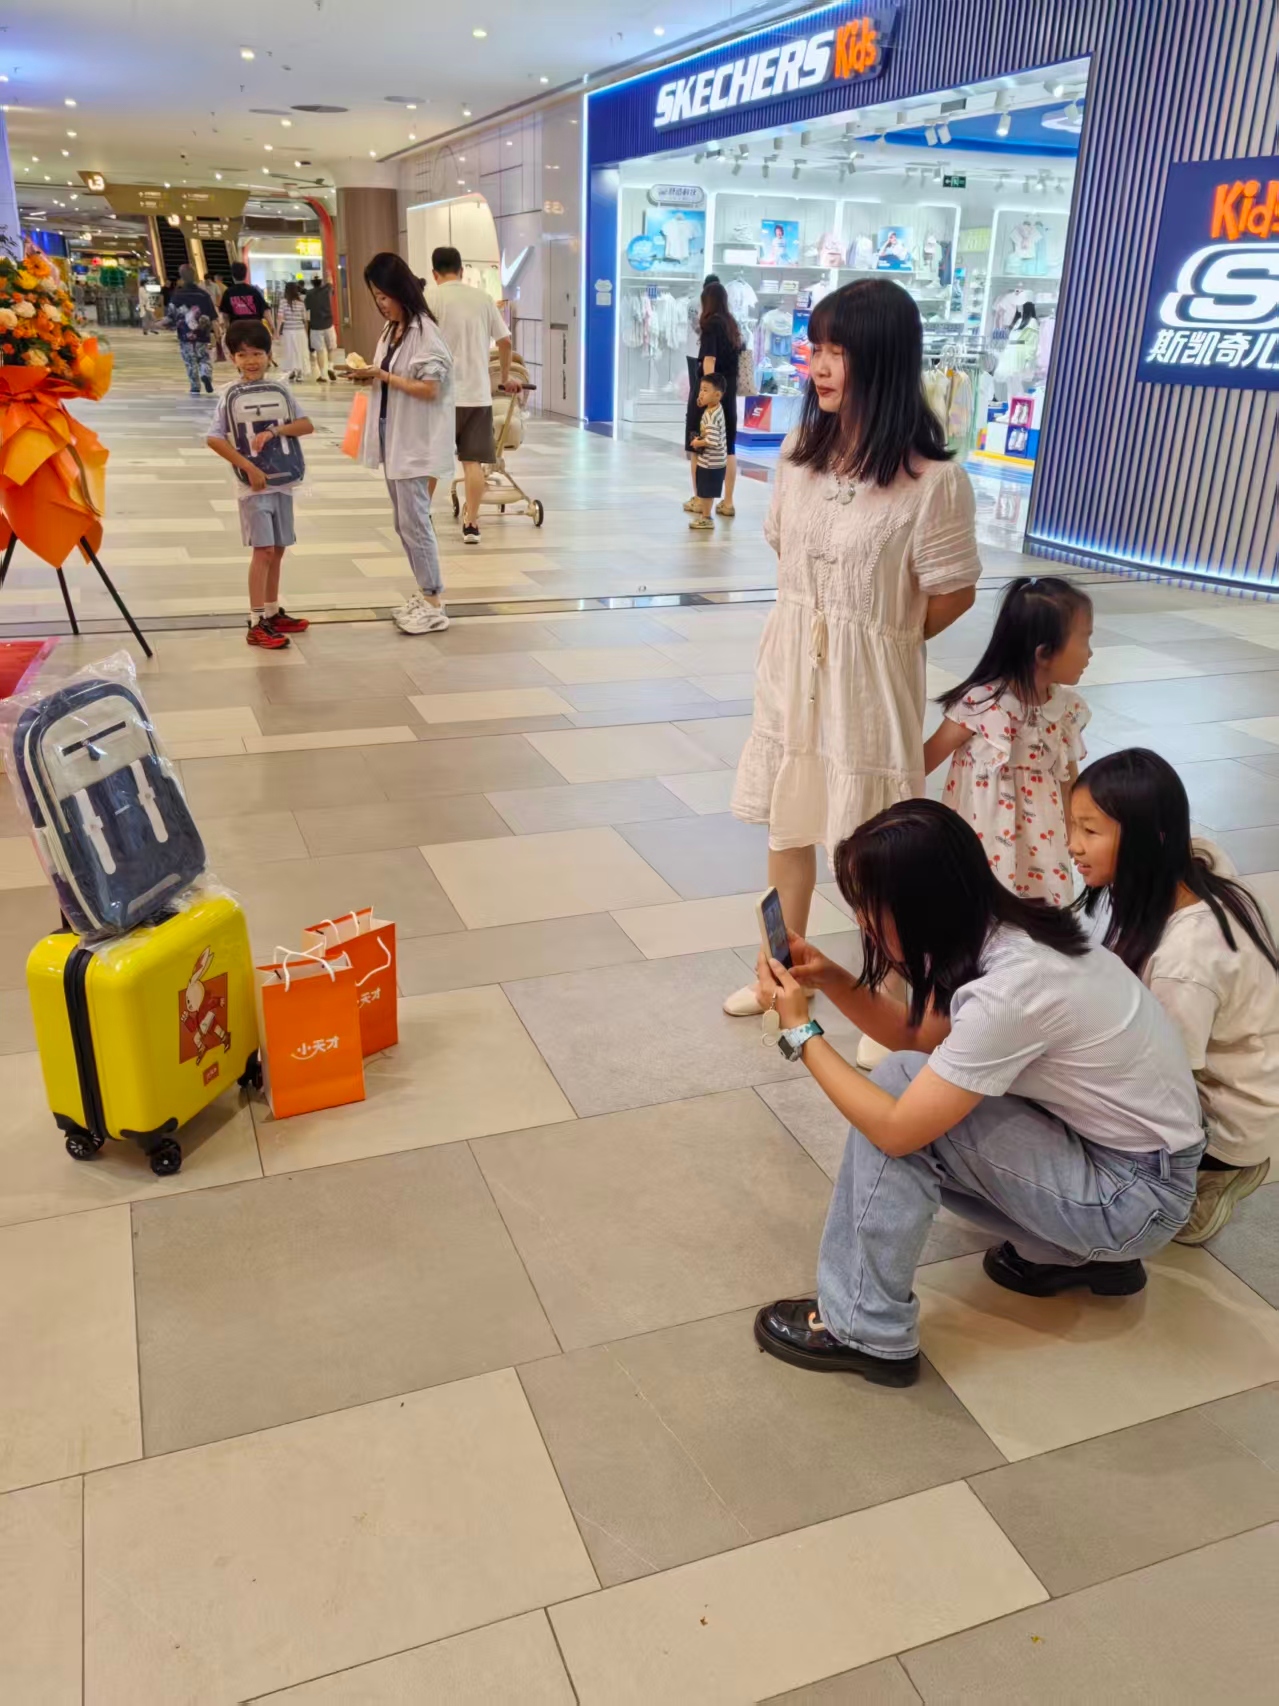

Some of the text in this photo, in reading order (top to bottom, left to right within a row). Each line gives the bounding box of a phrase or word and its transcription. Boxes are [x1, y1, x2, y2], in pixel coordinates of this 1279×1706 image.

[653, 16, 879, 128] SKECHERS Kids
[1145, 328, 1279, 370] 斯凯奇儿
[356, 986, 381, 1009] 天才
[290, 1035, 340, 1060] 小天才
